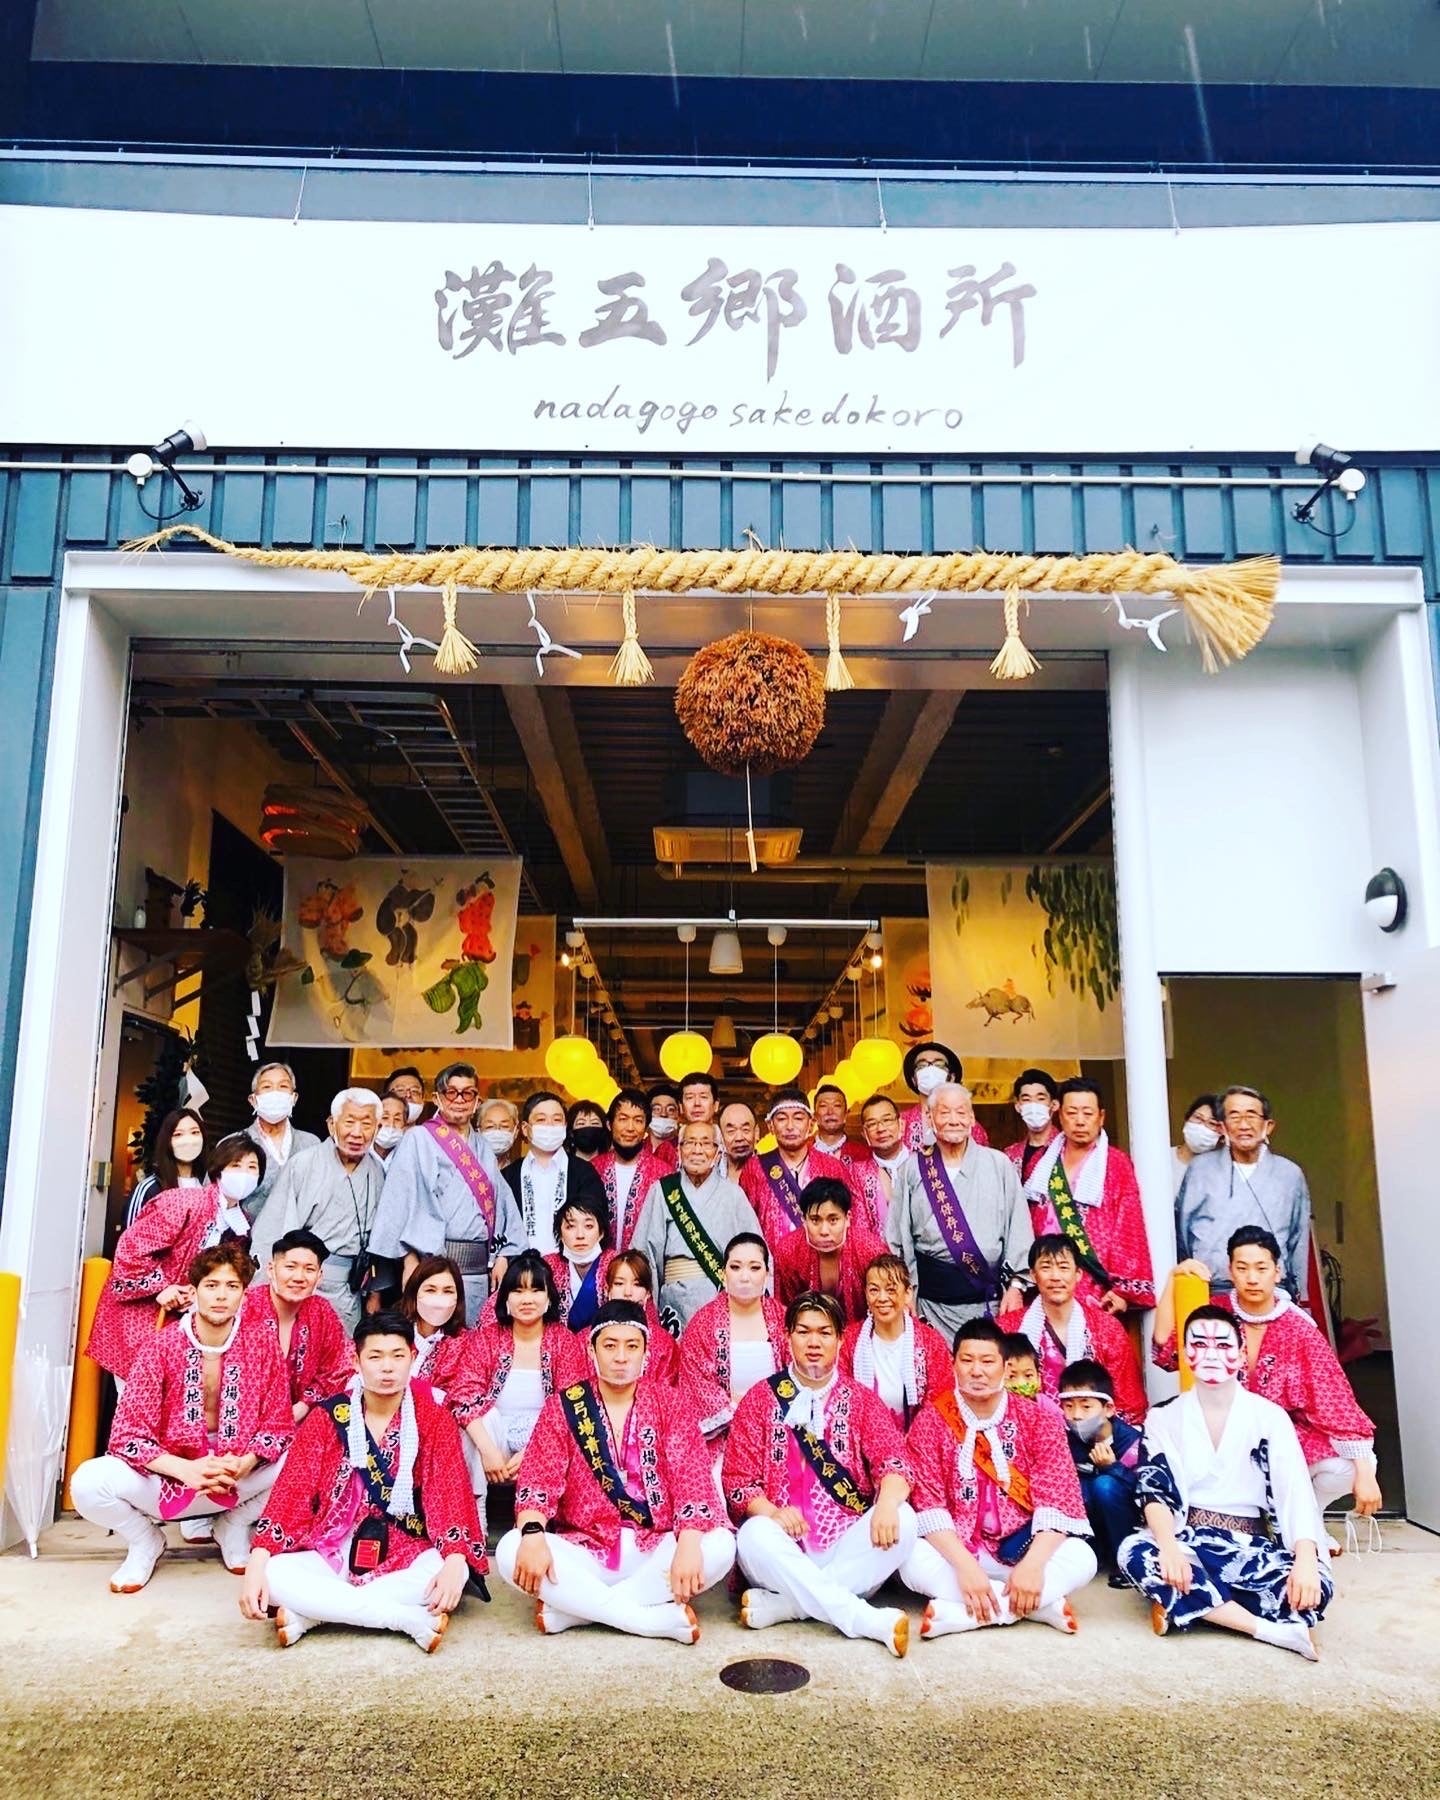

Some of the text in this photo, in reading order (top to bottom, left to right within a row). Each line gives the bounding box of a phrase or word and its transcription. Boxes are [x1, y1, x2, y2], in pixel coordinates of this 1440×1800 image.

[434, 257, 1037, 383] 灘五郷酒所
[534, 385, 718, 434] nadagogo
[573, 1401, 614, 1492] 弓場青年会
